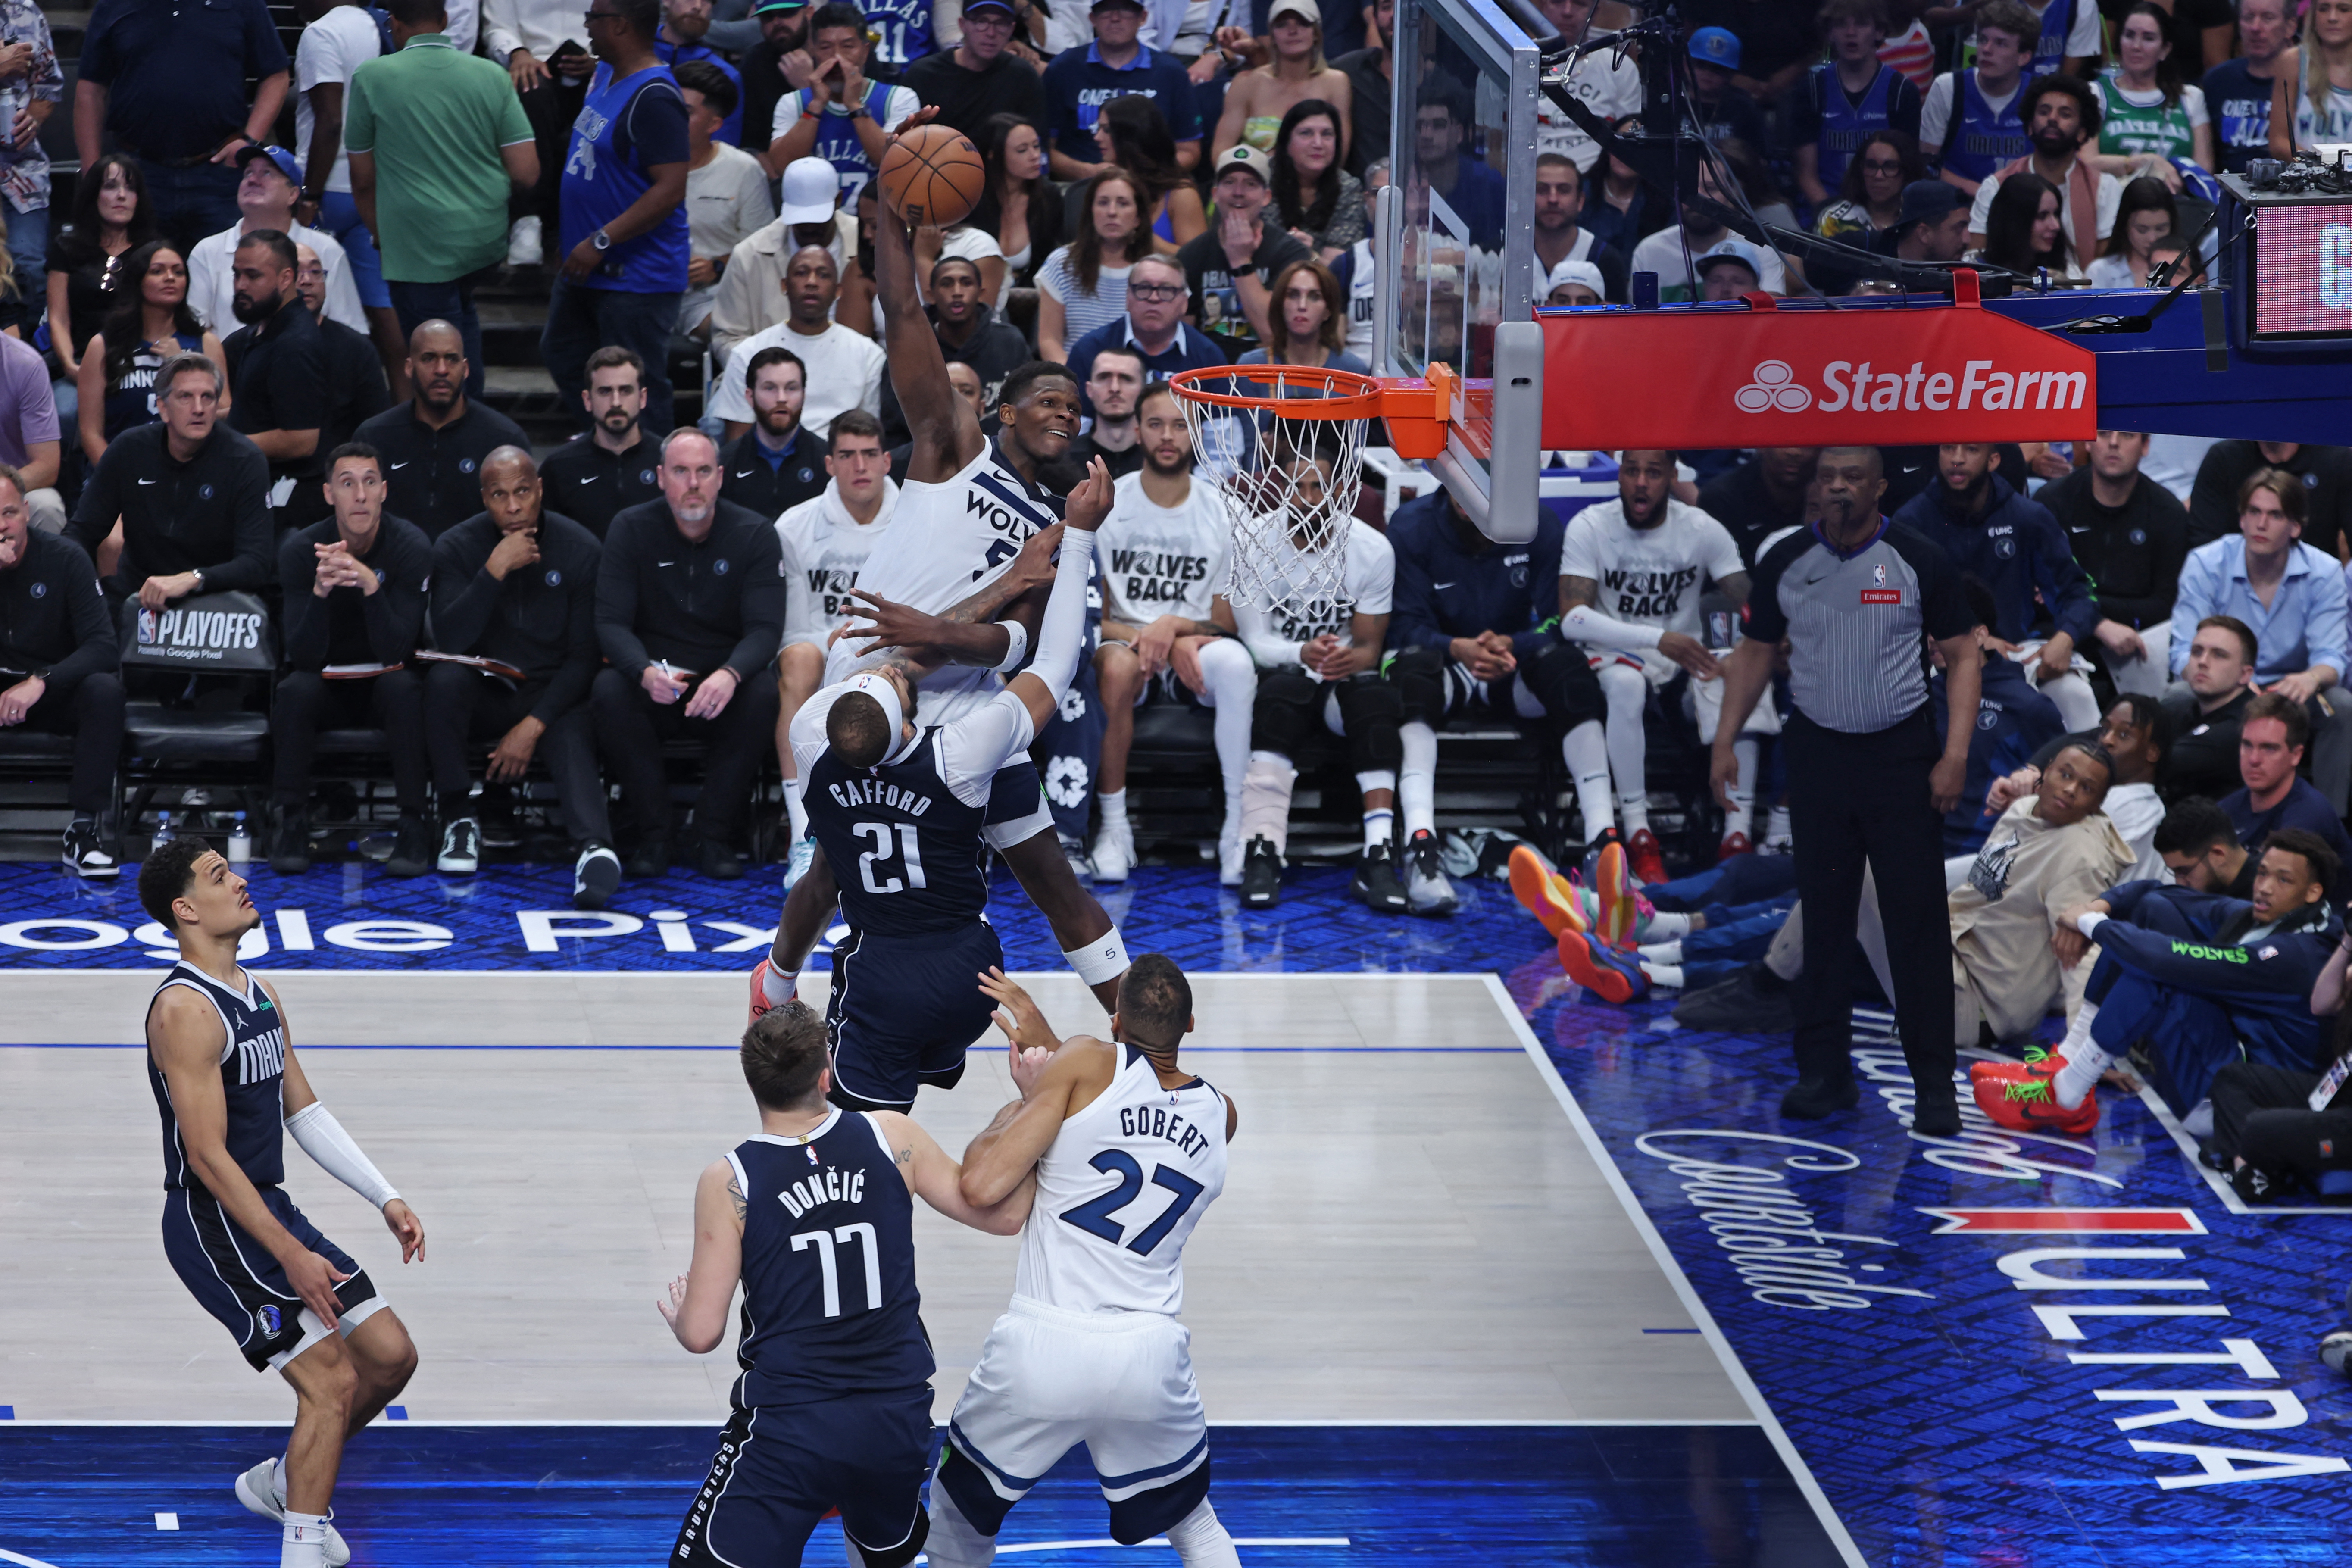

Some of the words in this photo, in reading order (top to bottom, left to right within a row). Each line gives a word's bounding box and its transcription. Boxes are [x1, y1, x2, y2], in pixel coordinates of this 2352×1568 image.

[855, 0, 928, 28] LLAS
[1112, 549, 1208, 581] WOLVES
[1604, 565, 1697, 595] WOLVES
[1126, 577, 1189, 602] BACK
[1618, 591, 1679, 616] BACK
[1864, 593, 1897, 601] Emirates
[157, 609, 262, 649] PLAYOFFS
[166, 646, 200, 660] Google
[200, 649, 223, 660] Pixel
[828, 778, 932, 817] GAFFORD
[852, 822, 927, 894] 21
[516, 910, 853, 952] Pix
[1105, 947, 1116, 961] 5
[2171, 938, 2249, 964] WOLVES
[1120, 1106, 1209, 1159] GOBERT
[778, 1165, 865, 1219] DONČIĆ
[1059, 1148, 1205, 1257] 27
[790, 1222, 883, 1318] 77
[1996, 1247, 2352, 1490] ULTRA
